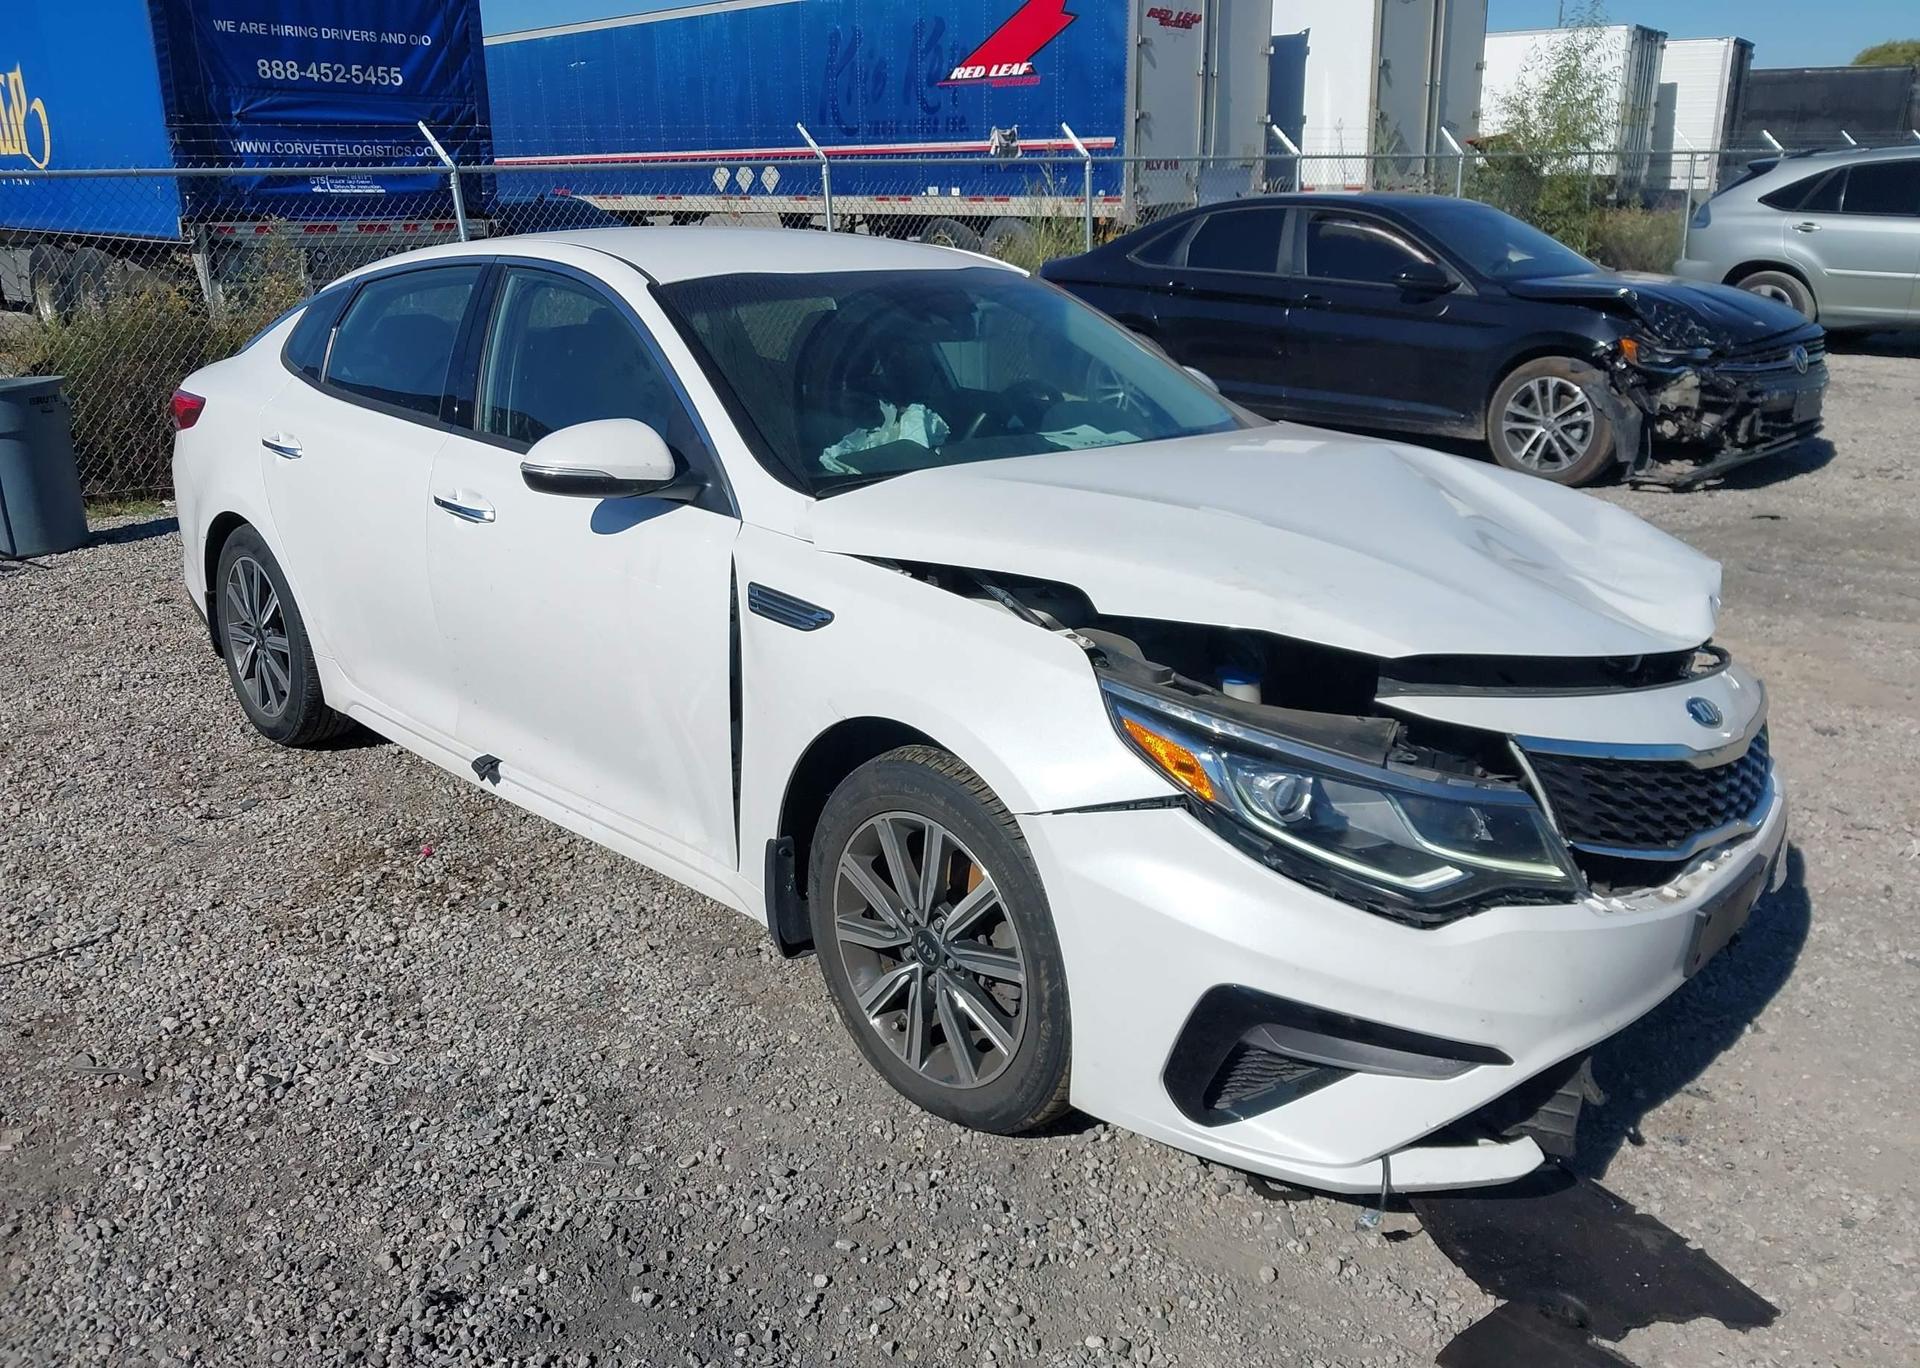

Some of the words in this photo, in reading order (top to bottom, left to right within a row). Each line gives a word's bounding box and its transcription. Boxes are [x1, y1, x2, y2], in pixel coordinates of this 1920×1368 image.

[213, 19, 236, 32] WE
[239, 22, 268, 35] ARE
[270, 25, 318, 39] HIRING
[321, 28, 378, 43] DRIVERS
[380, 32, 407, 45] AND
[410, 34, 432, 46] O/O
[257, 59, 404, 86] 888-452-5455
[950, 65, 986, 80] RED
[989, 62, 1033, 77] LEAF
[230, 141, 438, 157] WWW.CORVETTELOGISTICS.CO
